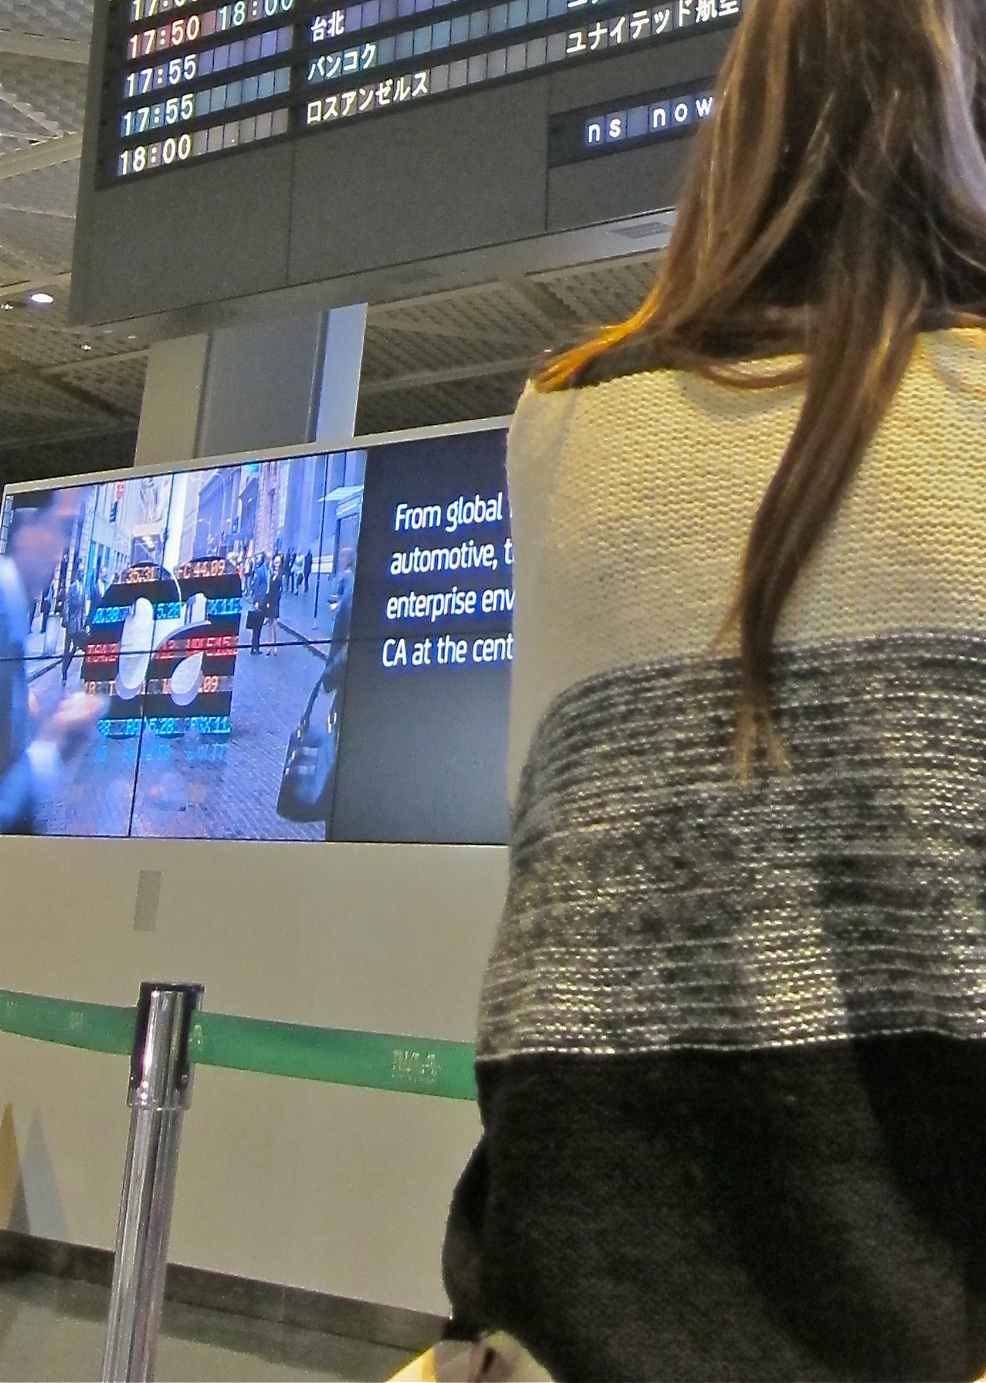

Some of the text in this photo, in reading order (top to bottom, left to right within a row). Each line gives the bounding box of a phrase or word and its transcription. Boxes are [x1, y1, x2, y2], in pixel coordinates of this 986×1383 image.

[310, 9, 345, 43] 台北
[126, 53, 197, 97] 17:55
[306, 71, 428, 125] ロスアンゼルス
[119, 133, 192, 175] 18:00
[394, 491, 503, 532] From global
[390, 539, 498, 575] automotive,
[386, 585, 477, 622] enterprise
[382, 638, 407, 667] CA
[411, 637, 432, 666] at
[437, 634, 468, 663] the
